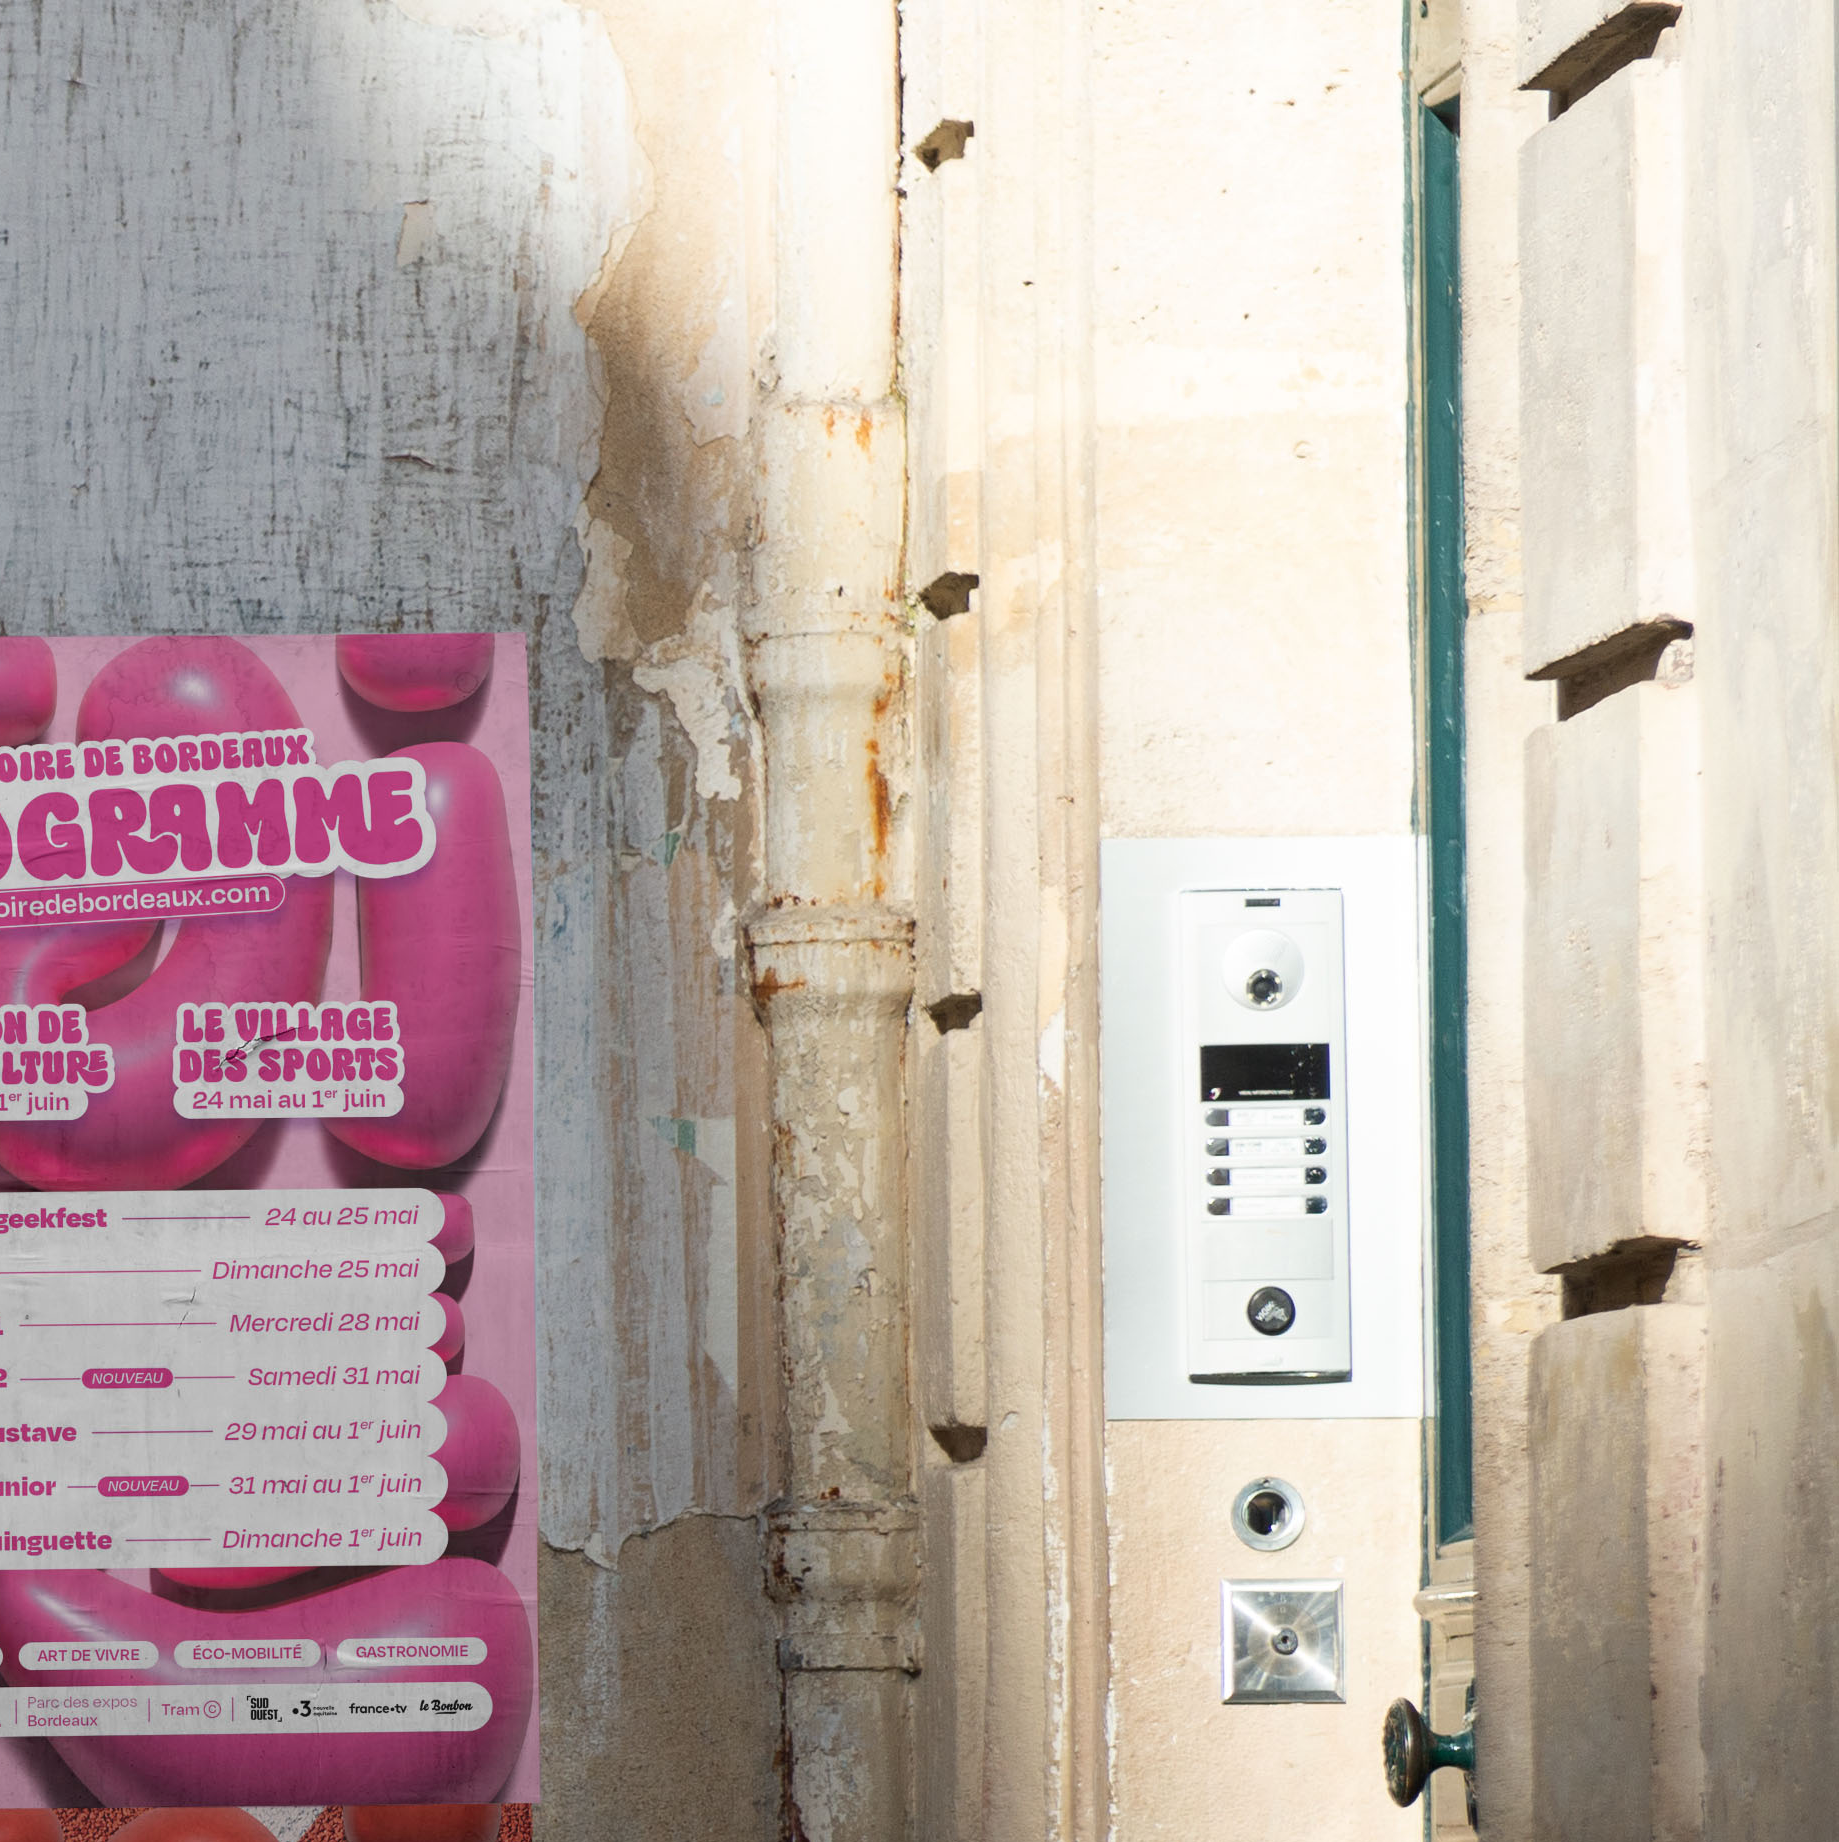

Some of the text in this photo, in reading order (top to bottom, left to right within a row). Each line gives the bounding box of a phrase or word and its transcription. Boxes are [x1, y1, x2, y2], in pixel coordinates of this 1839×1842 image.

[84, 746, 123, 777] DE
[133, 735, 309, 774] BORDEAUX
[38, 1011, 82, 1044] DE
[183, 1007, 394, 1043] LE VILLAGE
[180, 1048, 398, 1082] DES SPORTS
[265, 1208, 296, 1225] 24
[303, 1211, 331, 1225] au
[337, 1207, 369, 1225] 25
[374, 1205, 419, 1224] mai
[213, 1260, 332, 1279] Dimanche
[338, 1260, 369, 1278] 25
[375, 1263, 418, 1277] mai
[230, 1313, 332, 1332] Mercredi
[338, 1314, 369, 1331] 28
[376, 1316, 419, 1330] mai
[92, 1373, 163, 1384] NOUVEAU
[249, 1365, 420, 1385] Samedi 31 mai
